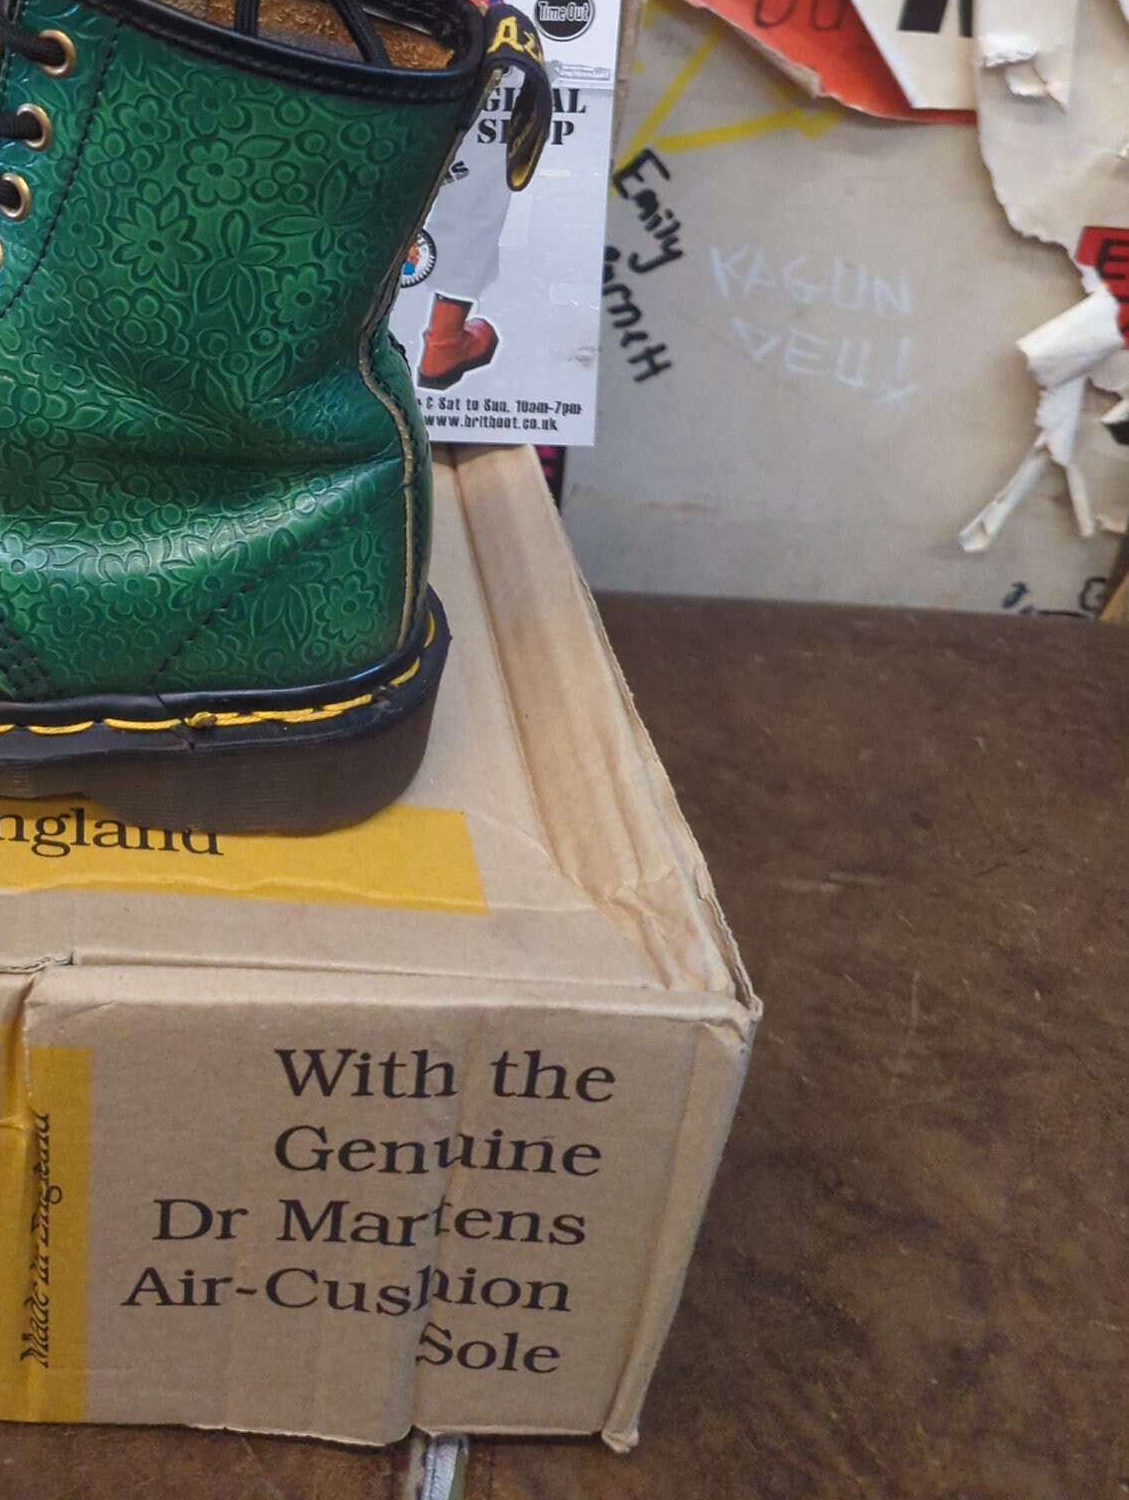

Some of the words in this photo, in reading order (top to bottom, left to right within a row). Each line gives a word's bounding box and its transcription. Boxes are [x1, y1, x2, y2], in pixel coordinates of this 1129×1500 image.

[539, 1, 565, 22] Time
[569, 2, 590, 22] Out
[613, 148, 683, 274] Emily
[424, 414, 558, 431] www.britboot.co.uk
[438, 397, 460, 411] Sat
[466, 399, 479, 412] to
[515, 400, 582, 417] 10am-7pm
[274, 1047, 458, 1100] With
[490, 1049, 617, 1102] the
[274, 1124, 603, 1177] Genuine
[152, 1197, 248, 1241] Dr
[276, 1197, 587, 1247] Martens
[121, 1265, 571, 1315] Air-Cushion
[415, 1321, 560, 1374] Sole
